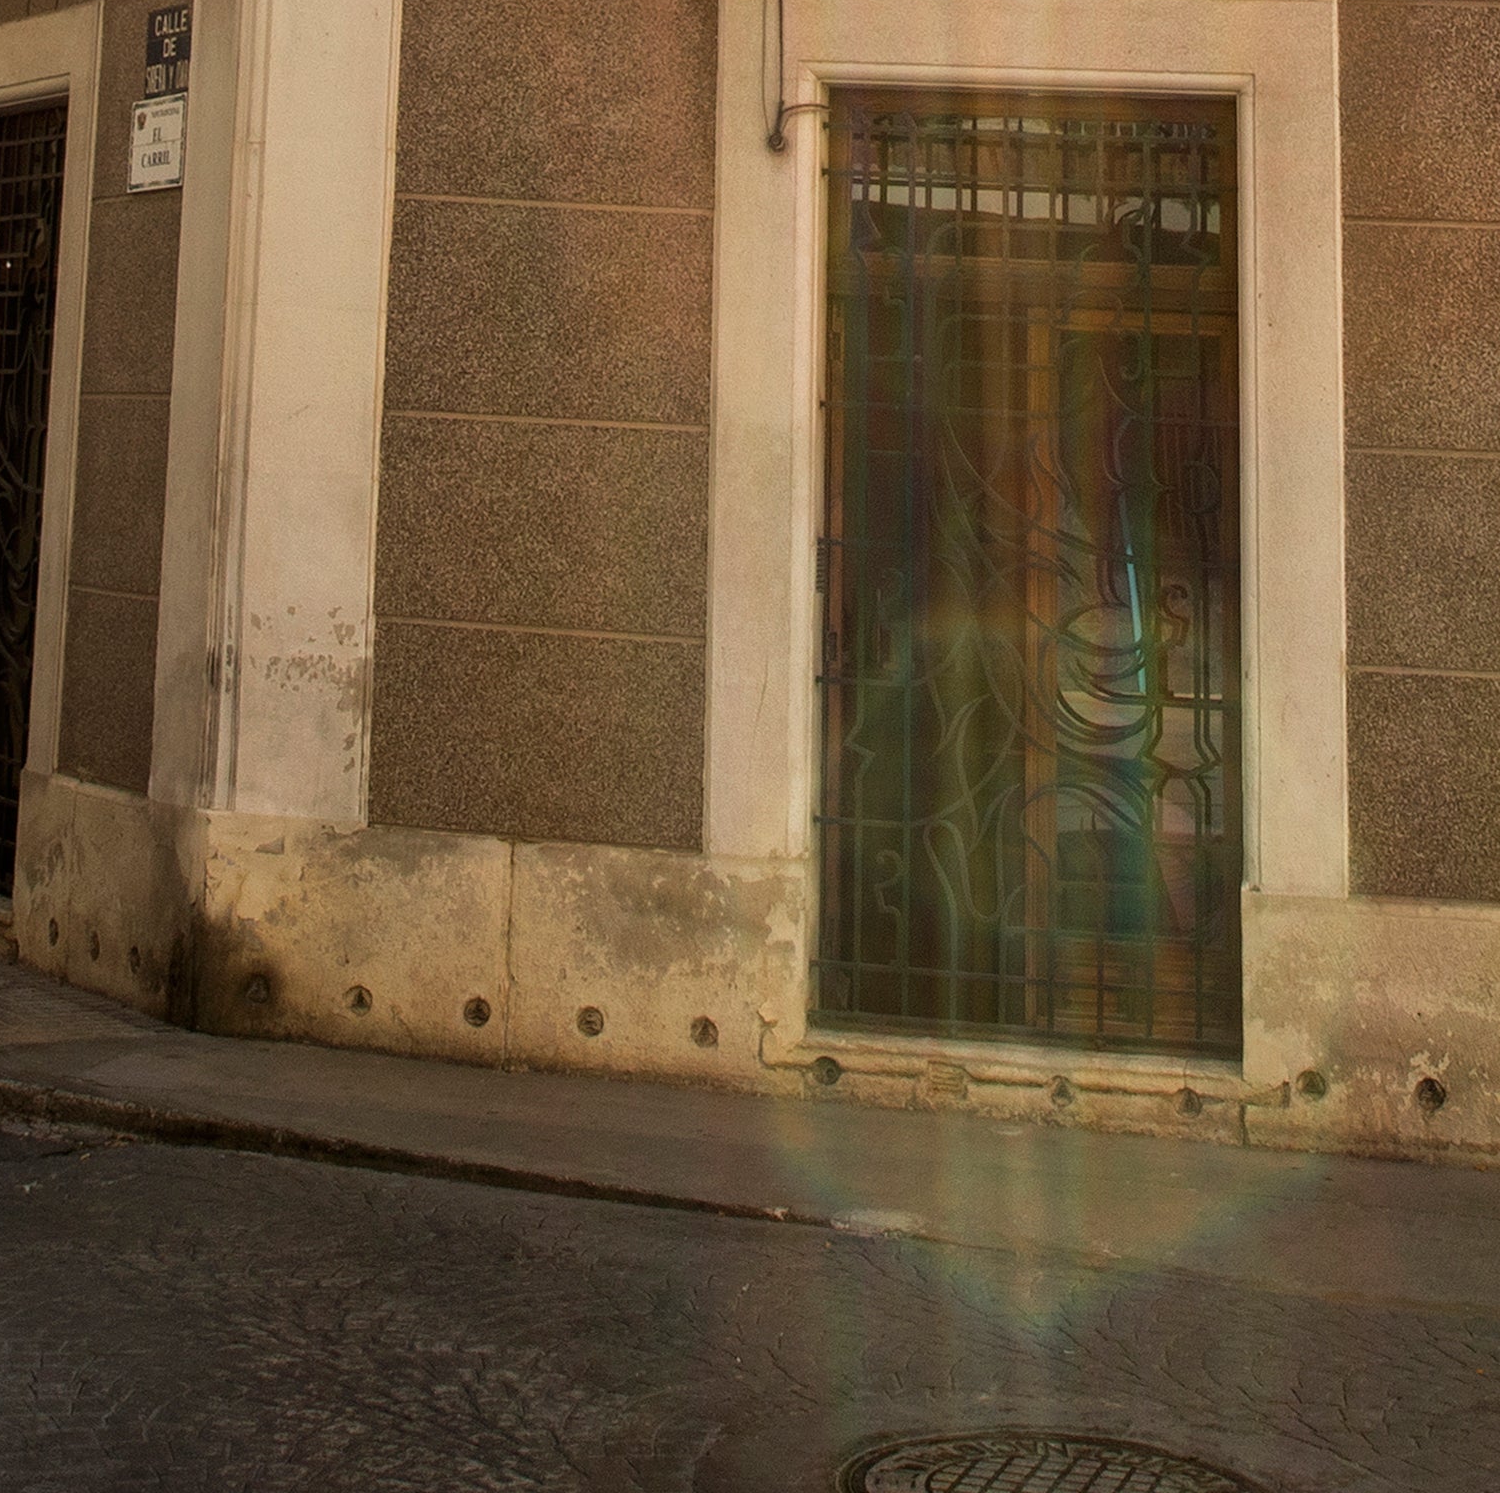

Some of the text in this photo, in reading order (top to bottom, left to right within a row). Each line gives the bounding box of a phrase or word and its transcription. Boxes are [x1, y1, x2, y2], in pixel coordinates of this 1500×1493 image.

[154, 9, 189, 37] CALLE
[162, 36, 178, 58] DE
[140, 149, 171, 169] CARRIL
